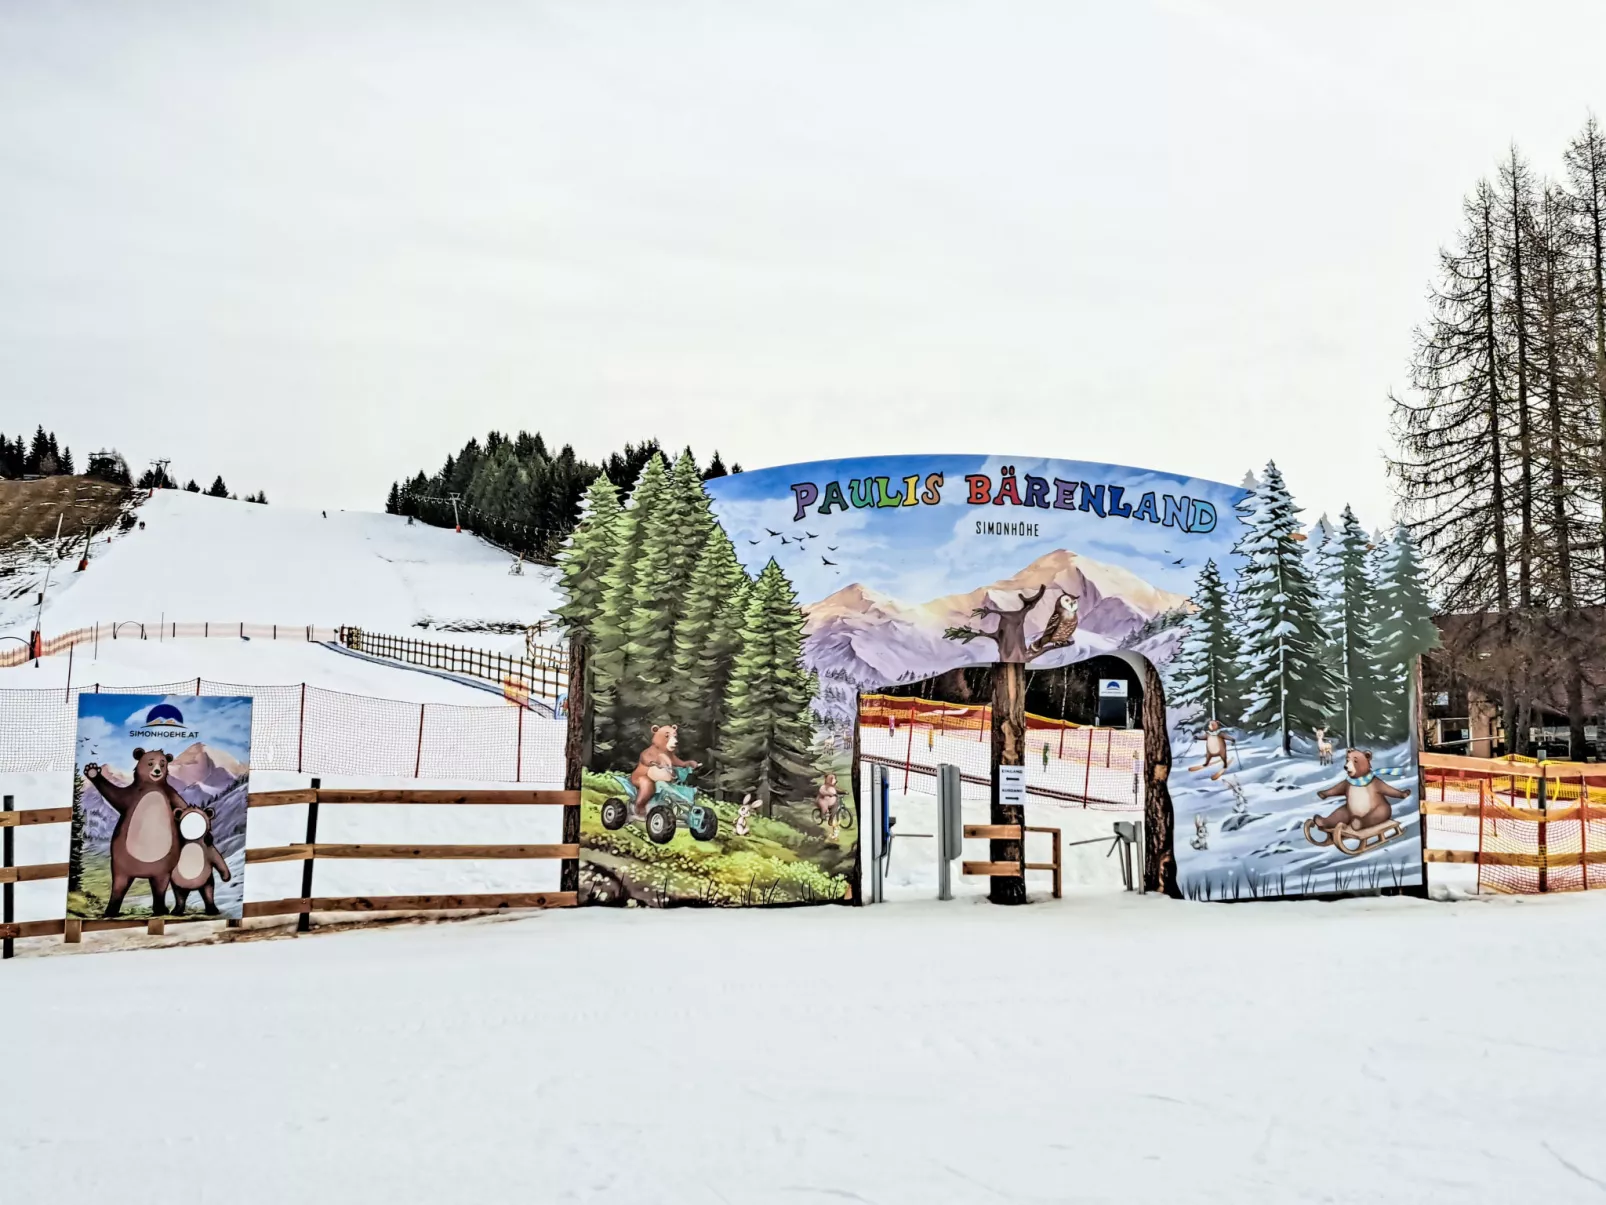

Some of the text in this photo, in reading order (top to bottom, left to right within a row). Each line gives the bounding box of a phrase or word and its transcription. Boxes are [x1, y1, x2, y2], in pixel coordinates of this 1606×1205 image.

[790, 465, 1218, 534] PAULIS BÄRENLAND
[975, 520, 1040, 537] SIMONHÖHE
[129, 730, 200, 739] SIMONHOEHE.AT
